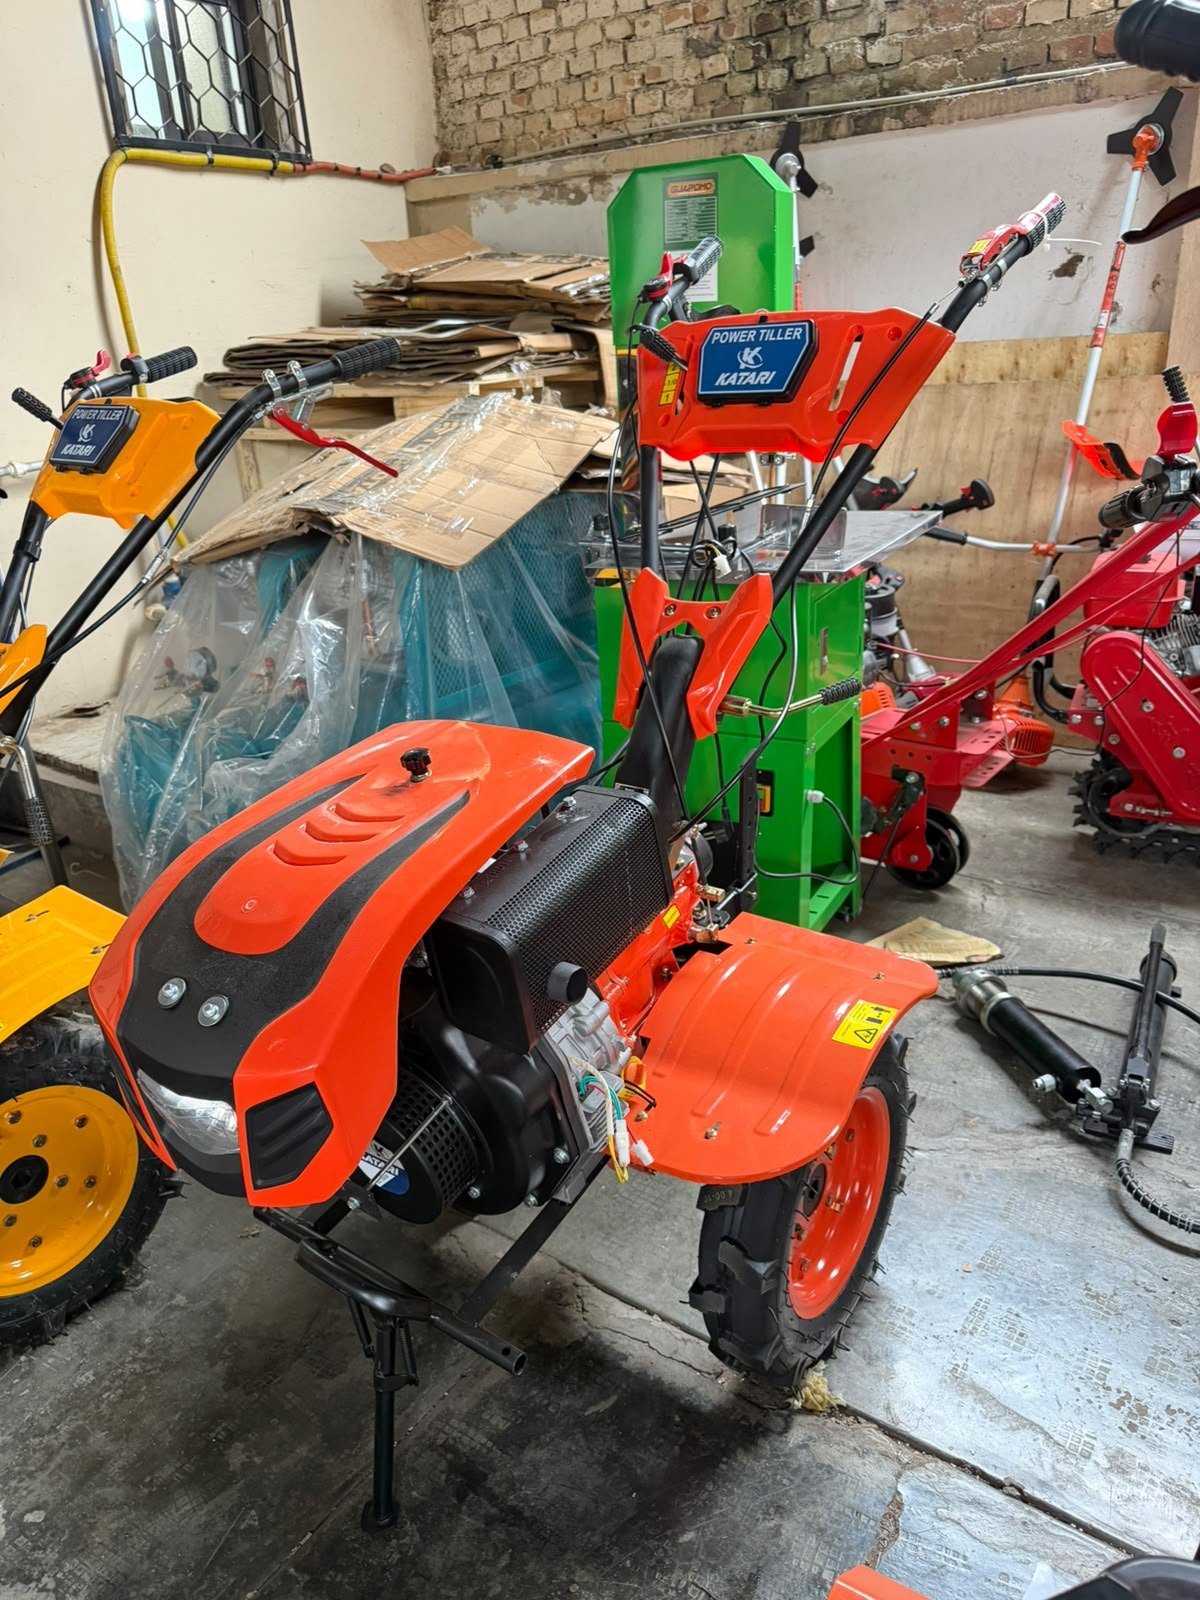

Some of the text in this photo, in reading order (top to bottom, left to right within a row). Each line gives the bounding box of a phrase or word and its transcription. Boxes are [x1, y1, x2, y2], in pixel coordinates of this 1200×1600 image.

[711, 327, 803, 345] POWER TILLER
[715, 371, 776, 386] KATARI
[72, 409, 122, 421] POWER TILLER
[60, 443, 97, 457] KATARI
